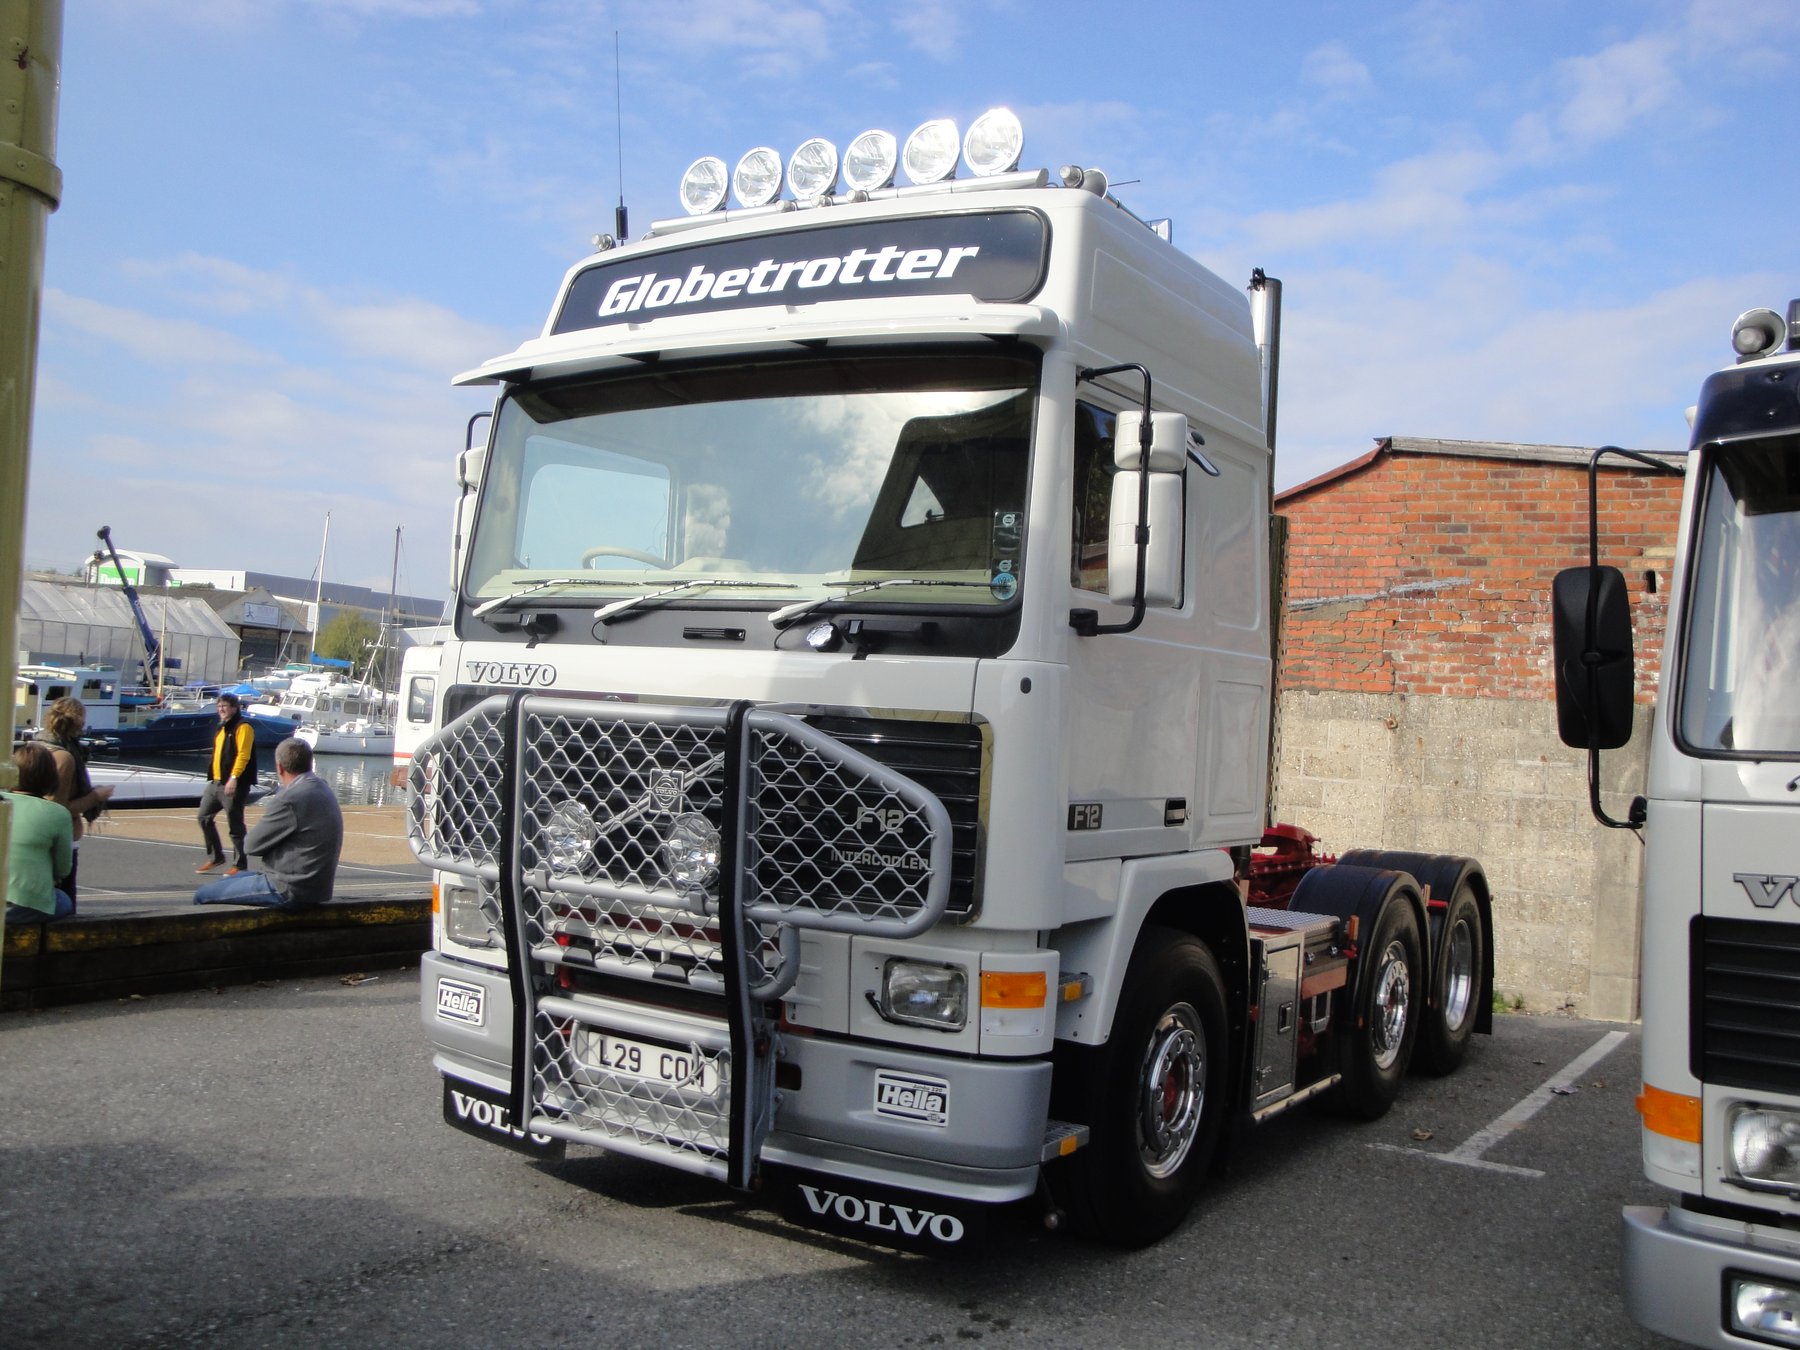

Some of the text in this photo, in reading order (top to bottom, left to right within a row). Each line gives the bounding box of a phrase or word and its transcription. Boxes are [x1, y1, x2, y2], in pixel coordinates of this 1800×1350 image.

[597, 245, 980, 317] Globetrotter
[466, 661, 557, 686] VOLVO
[655, 786, 678, 796] VOLVO
[856, 807, 904, 833] F12
[1073, 805, 1100, 828] F12
[831, 850, 929, 871] INTERCOOLER
[440, 990, 478, 1013] Hella
[600, 1038, 641, 1073] L29
[881, 1085, 942, 1111] Hella
[798, 1184, 965, 1242] VOLVO
